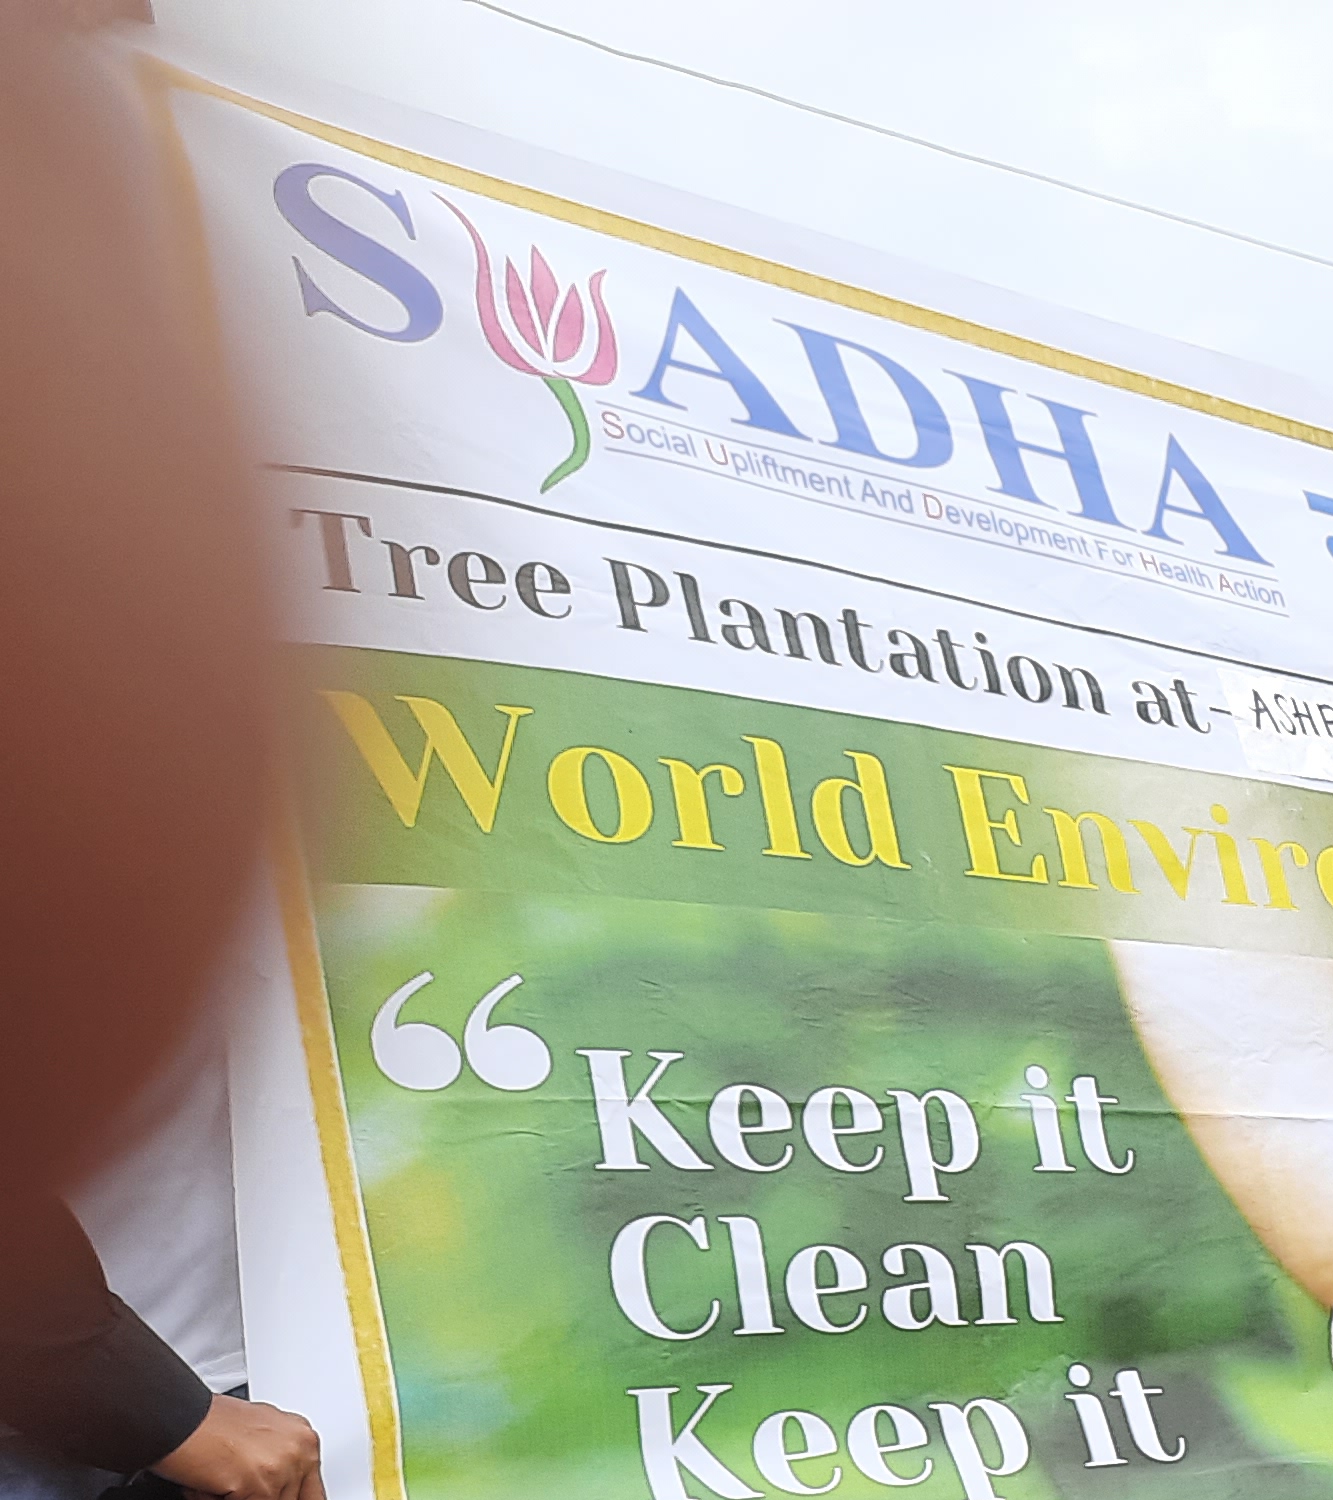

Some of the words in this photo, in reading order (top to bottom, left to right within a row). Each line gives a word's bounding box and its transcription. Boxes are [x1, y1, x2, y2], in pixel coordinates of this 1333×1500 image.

[601, 411, 697, 458] Social
[705, 439, 856, 500] Upliftment
[861, 479, 914, 514] And
[922, 493, 1091, 557] Development
[1095, 540, 1135, 568] For
[1140, 551, 1214, 591] Health
[1218, 573, 1286, 608] Action
[288, 508, 573, 619] Tree
[602, 556, 1112, 717] Plantation
[316, 690, 912, 872] World
[1019, 1065, 1135, 1175] it
[608, 1213, 1065, 1341] Clean
[1063, 1363, 1187, 1469] it
